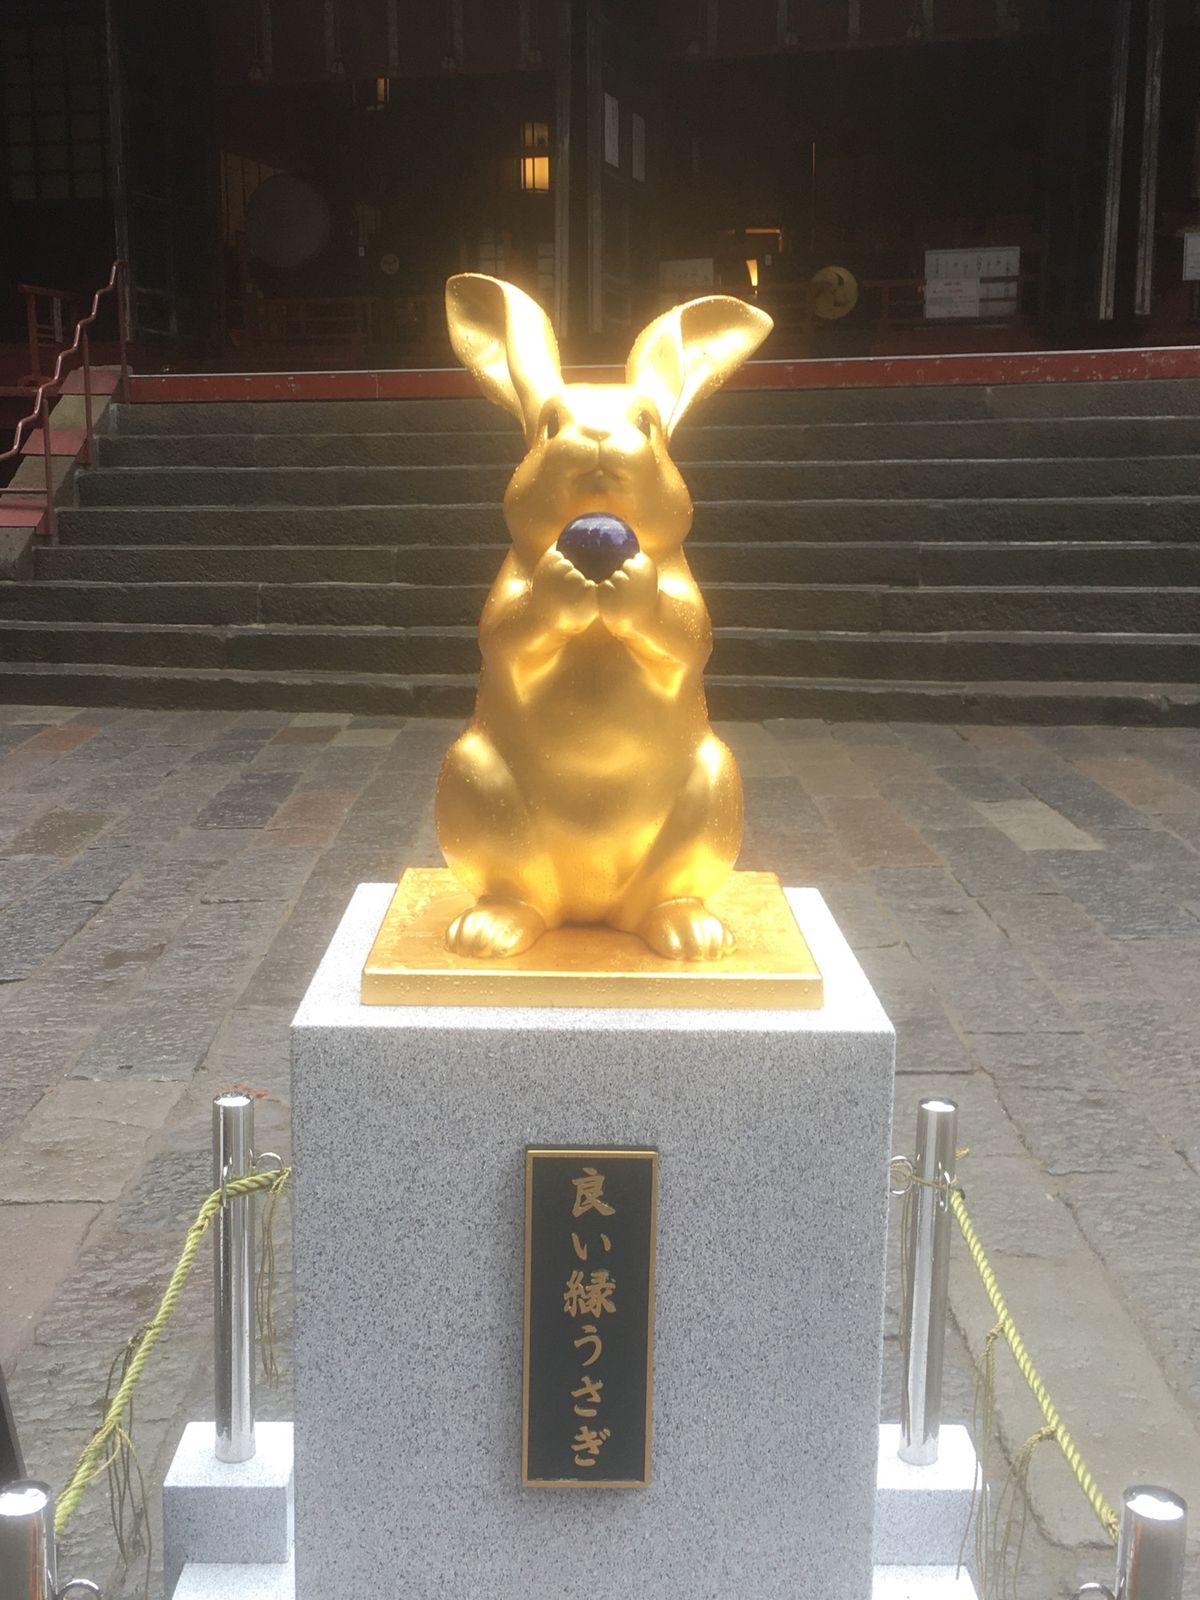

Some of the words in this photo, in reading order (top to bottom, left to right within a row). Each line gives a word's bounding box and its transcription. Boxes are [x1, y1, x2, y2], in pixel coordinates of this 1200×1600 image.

[563, 1167, 616, 1467] 良い縁うさぎ
